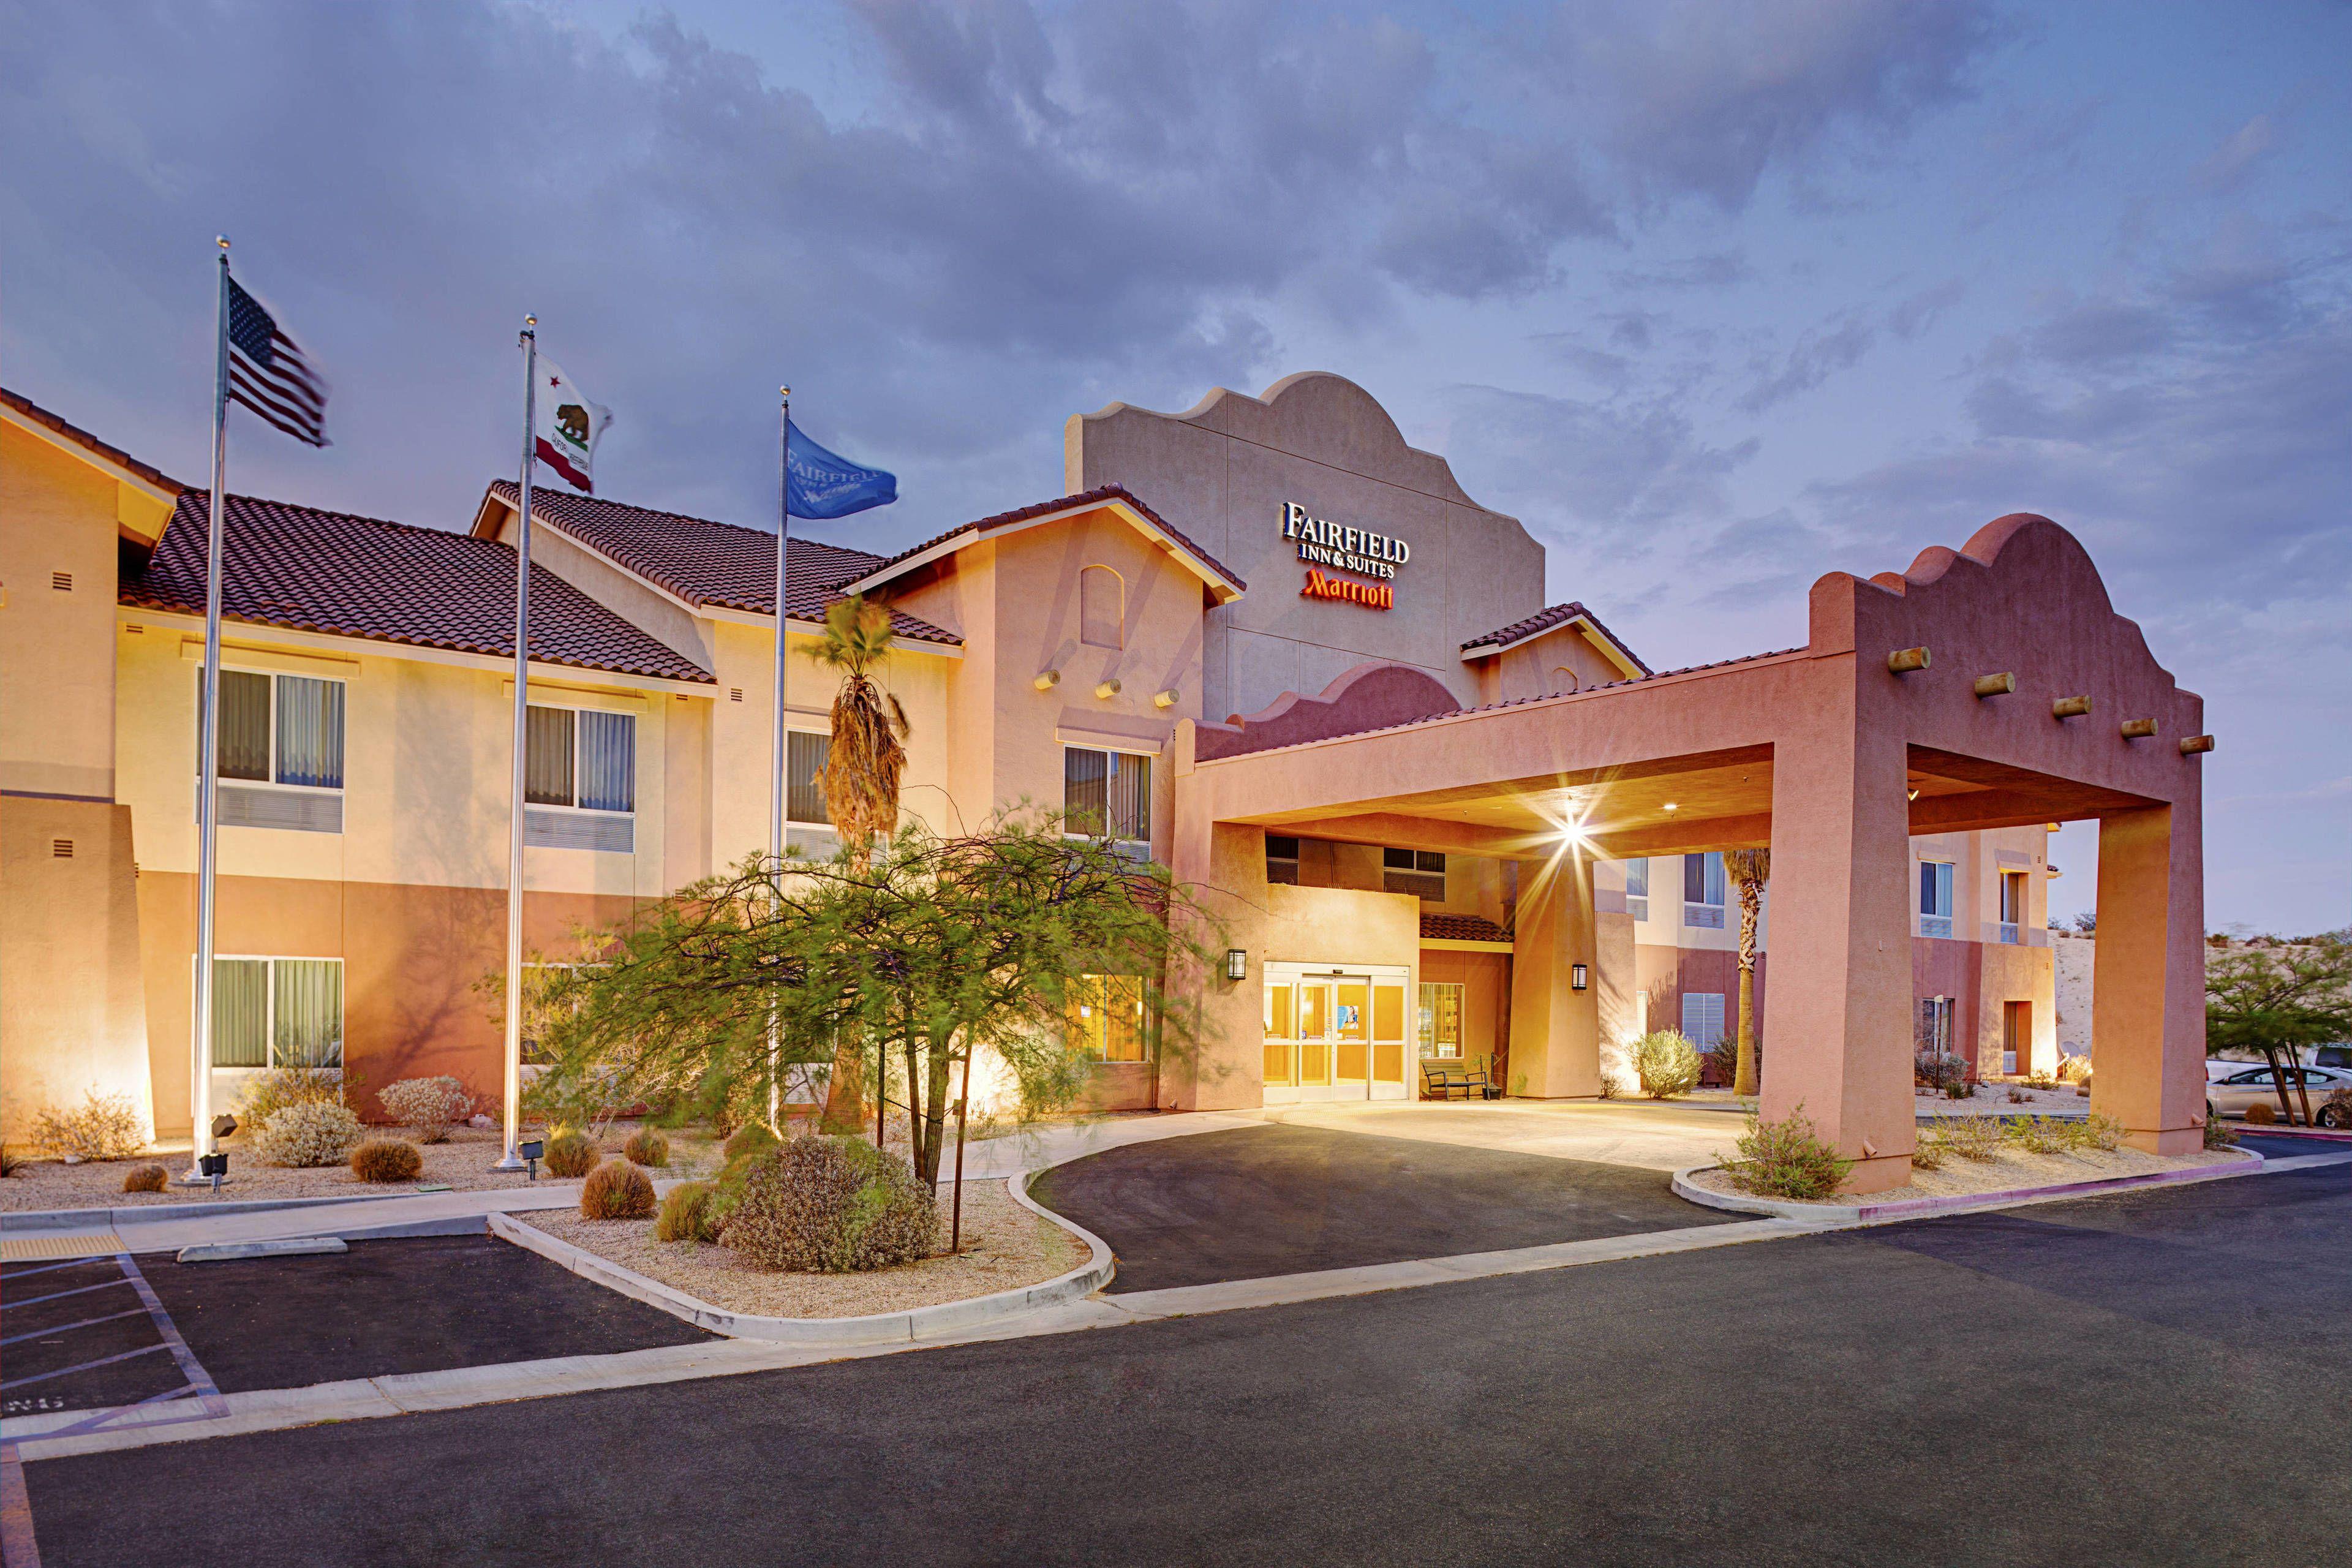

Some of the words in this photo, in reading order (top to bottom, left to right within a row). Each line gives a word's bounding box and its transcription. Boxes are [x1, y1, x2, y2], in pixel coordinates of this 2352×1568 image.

[1283, 502, 1409, 564] FAIRFIELD
[1298, 543, 1331, 564] INN
[1333, 551, 1344, 567] &
[1347, 554, 1395, 579] SUITES
[1300, 568, 1393, 610] Marriott
